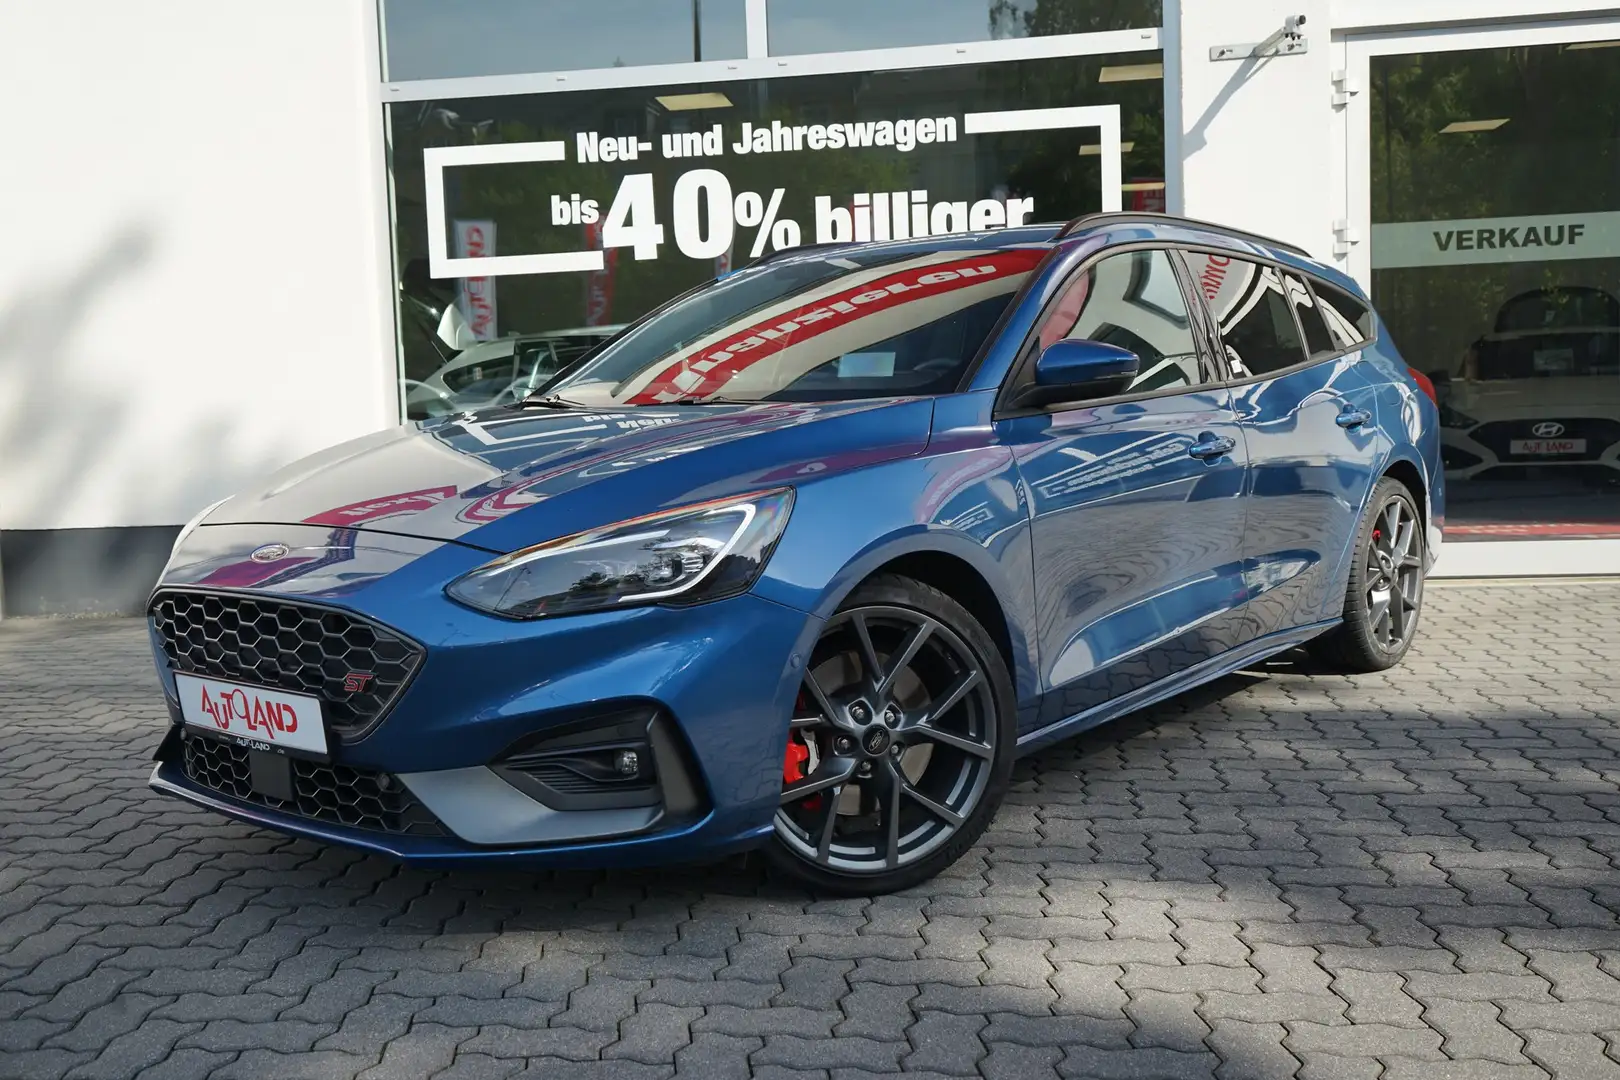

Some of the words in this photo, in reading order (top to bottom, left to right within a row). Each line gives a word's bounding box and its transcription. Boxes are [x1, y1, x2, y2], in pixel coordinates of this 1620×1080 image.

[576, 131, 653, 163] Neu-
[661, 124, 723, 158] und
[732, 115, 957, 155] Jahreswagen
[551, 193, 600, 226] bis
[602, 168, 801, 261] 40%
[815, 189, 1034, 244] billiger
[1433, 224, 1585, 251] VERKAUF
[344, 673, 373, 692] ST
